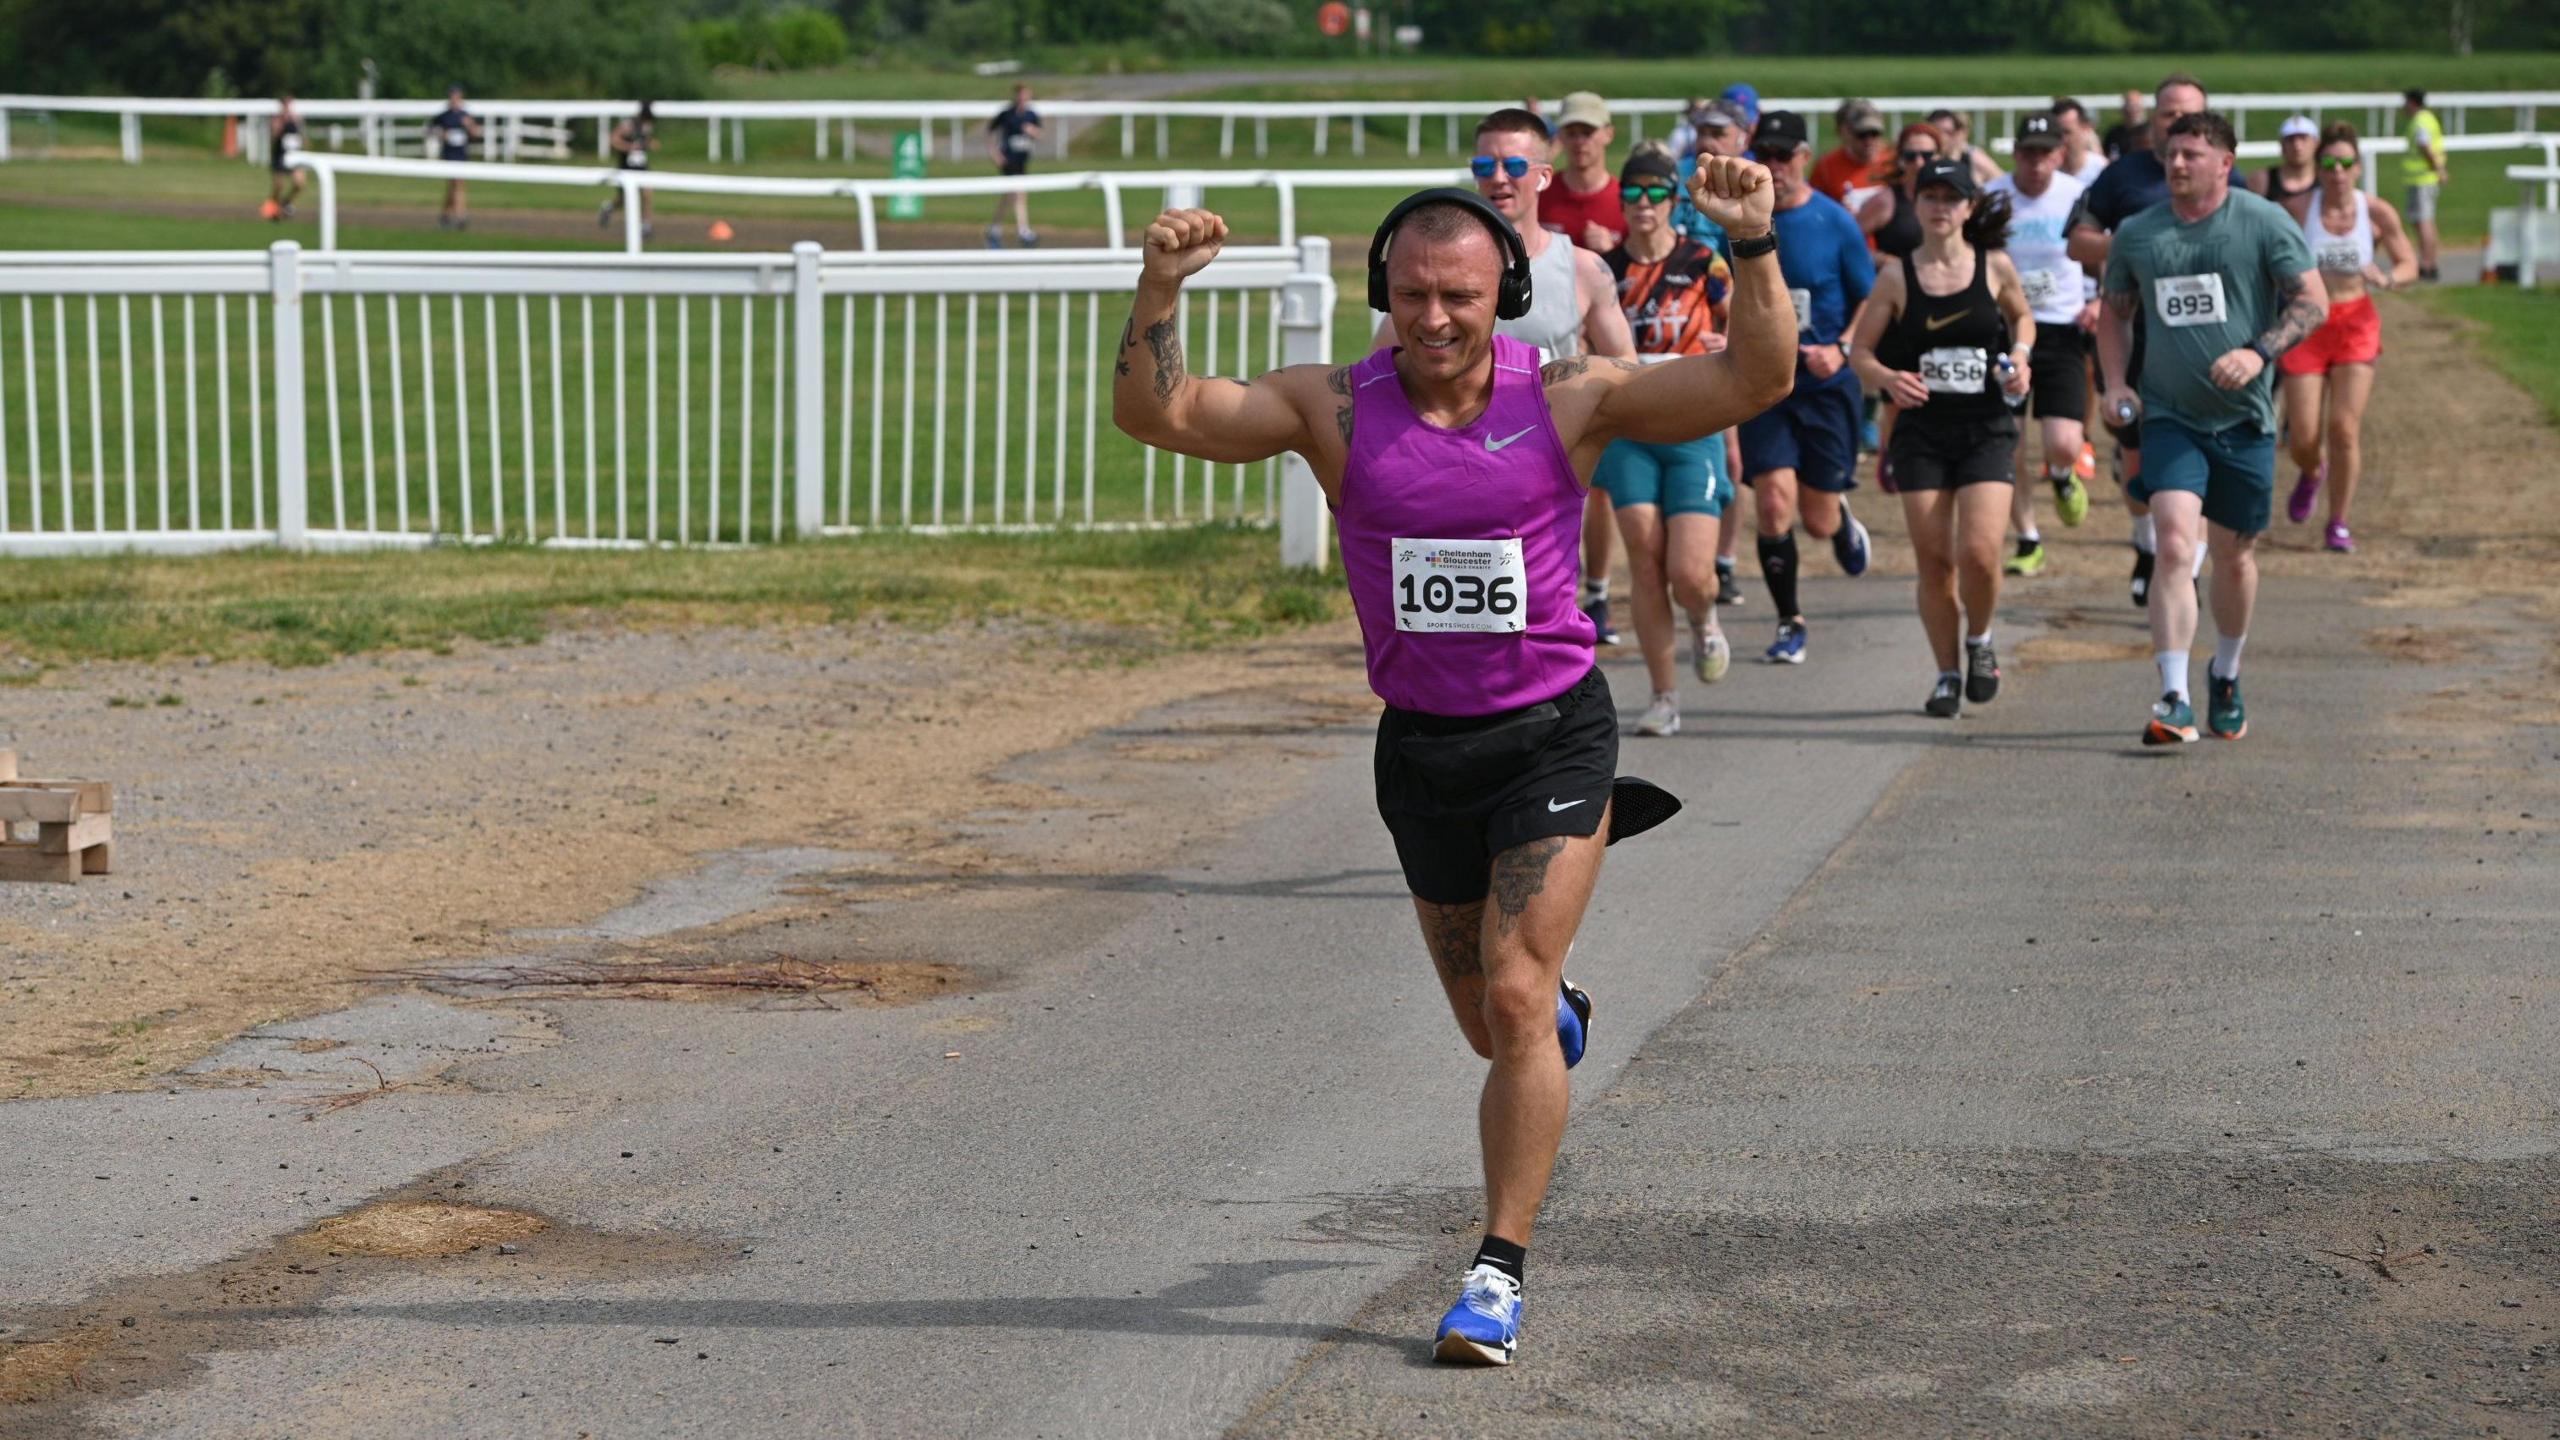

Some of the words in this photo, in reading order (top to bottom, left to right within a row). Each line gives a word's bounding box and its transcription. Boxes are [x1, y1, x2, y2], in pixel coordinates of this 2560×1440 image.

[2167, 294, 2214, 316] 893
[1923, 361, 1982, 381] 2658
[1438, 549, 1492, 558] Cheltenham
[1443, 557, 1492, 565] Gloucester
[1400, 573, 1518, 615] 1036
